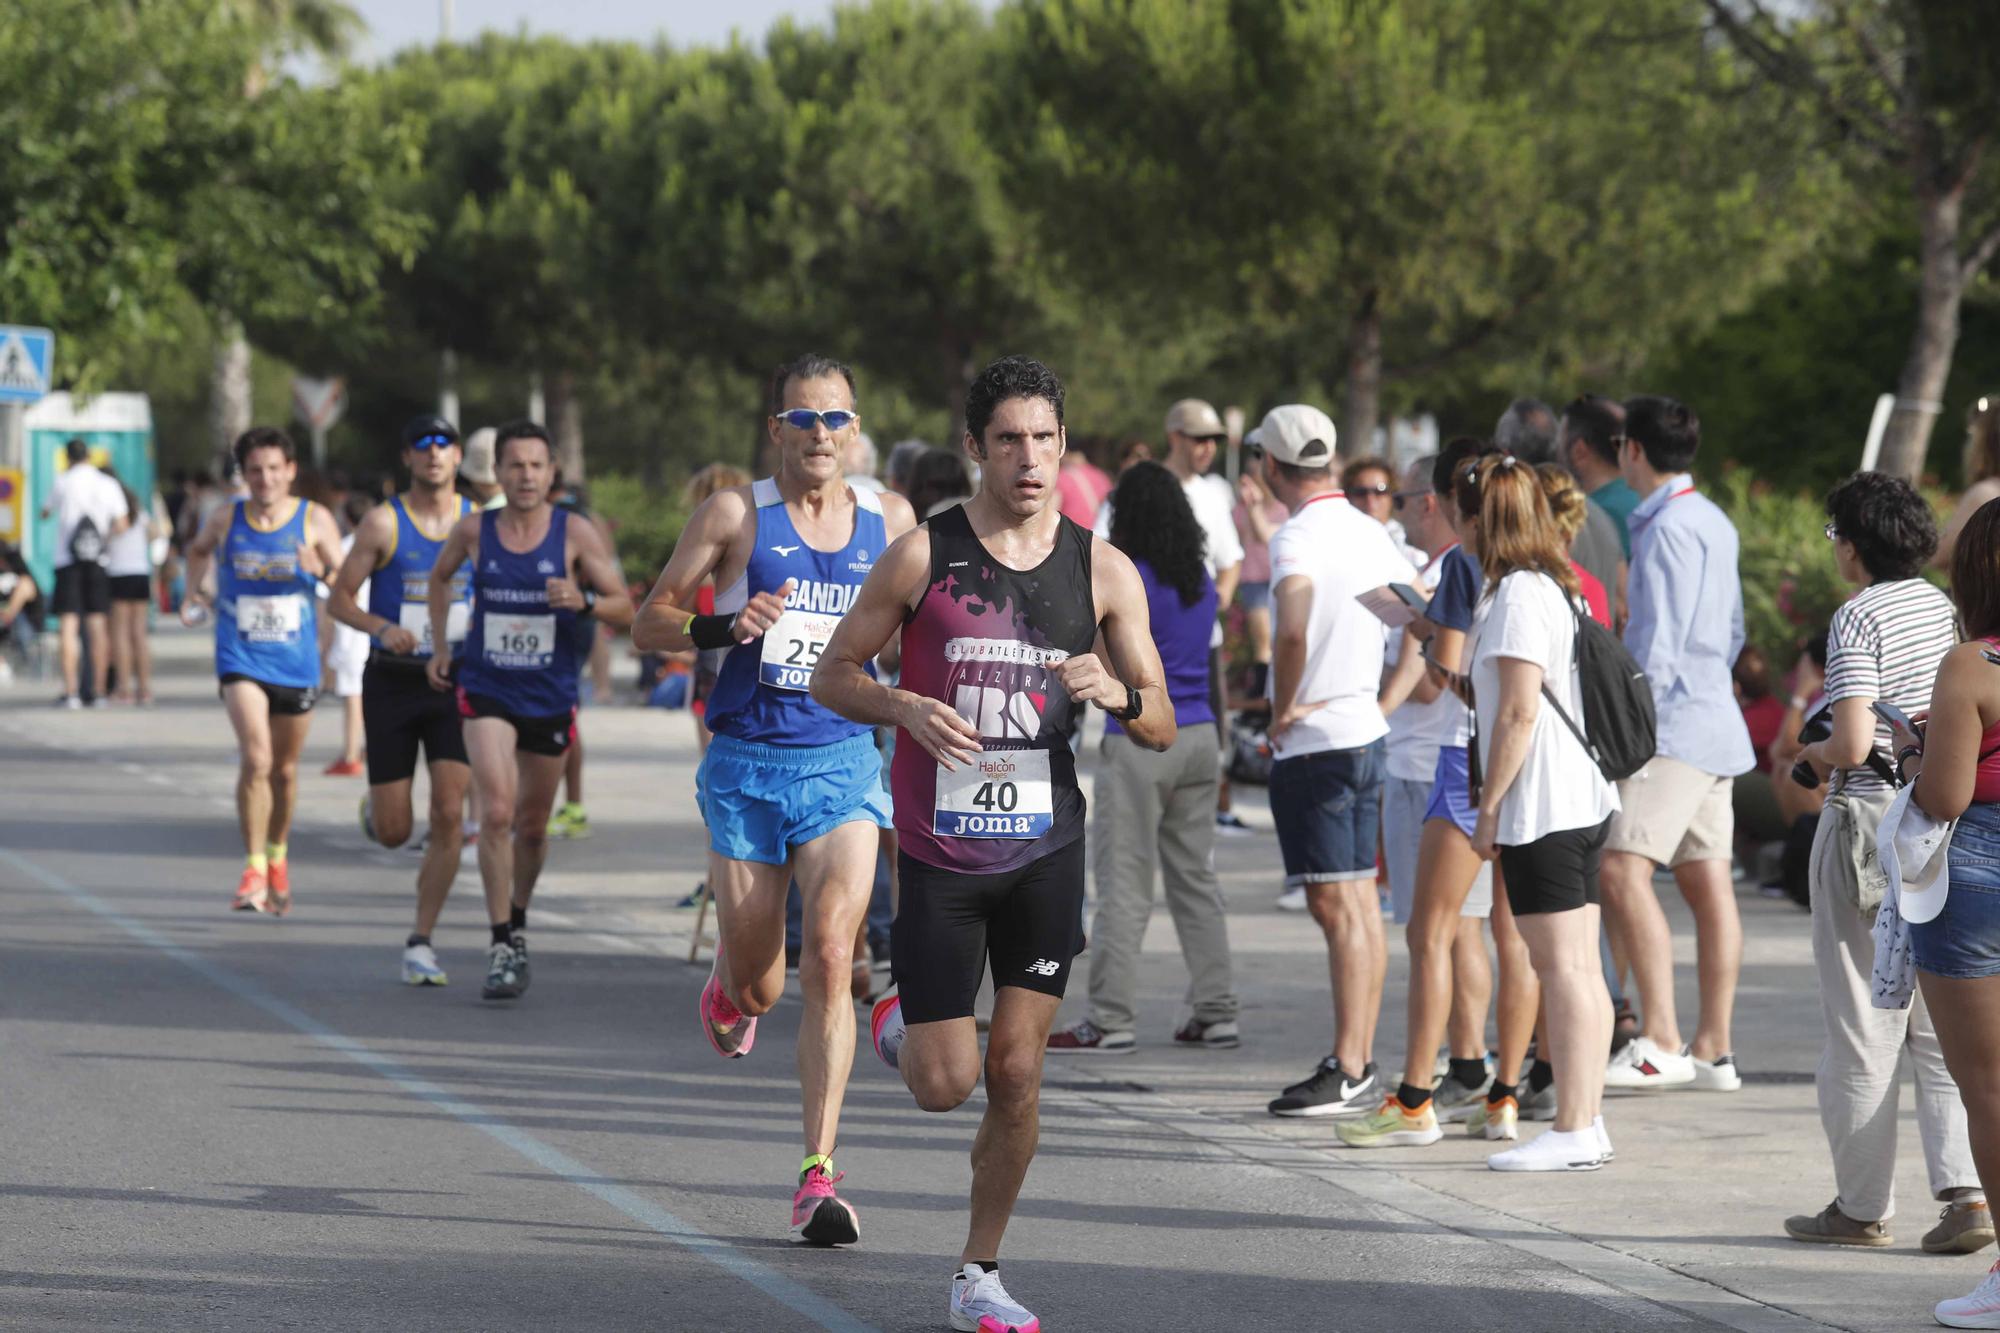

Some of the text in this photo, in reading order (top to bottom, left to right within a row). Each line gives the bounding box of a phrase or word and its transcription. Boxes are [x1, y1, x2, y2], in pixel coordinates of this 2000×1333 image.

[499, 633, 539, 653] 169
[959, 668, 1047, 690] ALZIRA
[973, 781, 1019, 813] 40
